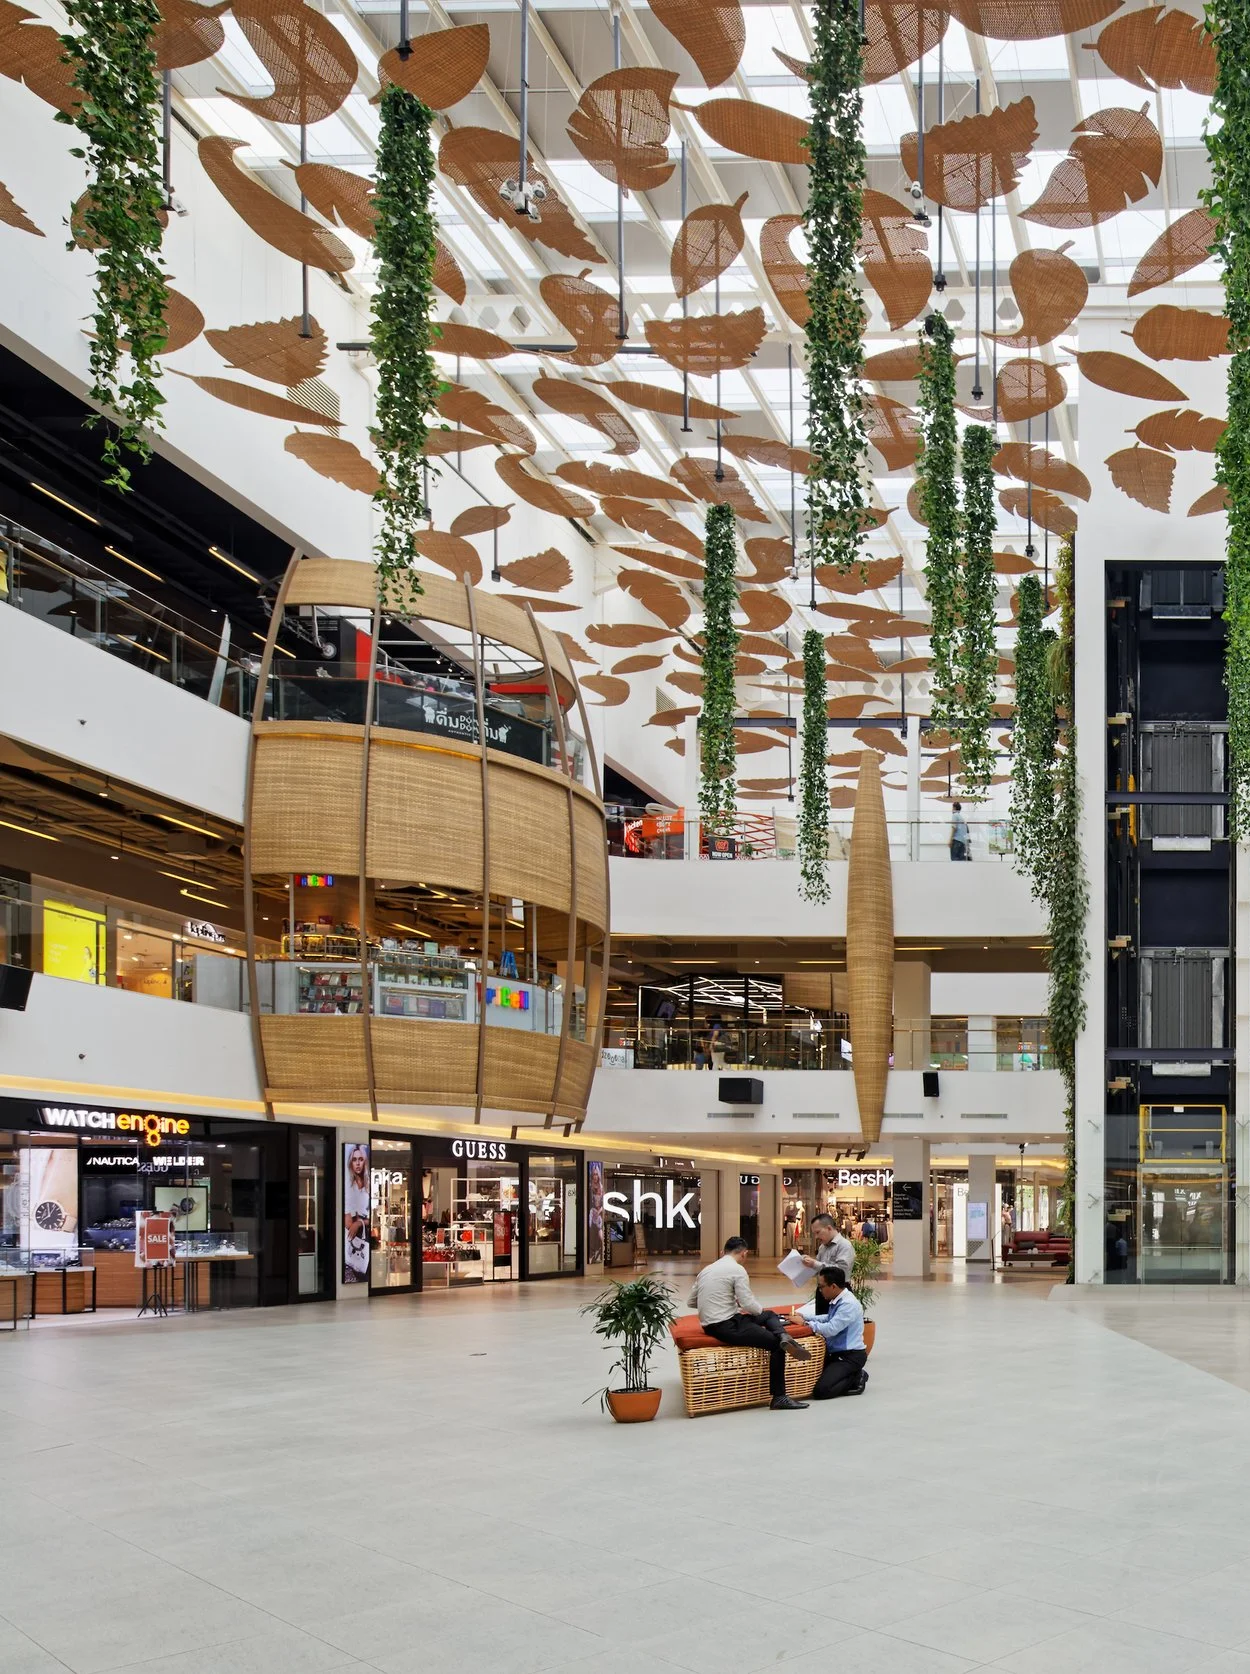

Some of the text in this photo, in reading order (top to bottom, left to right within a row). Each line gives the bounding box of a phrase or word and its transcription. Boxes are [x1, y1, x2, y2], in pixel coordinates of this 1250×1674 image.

[43, 1107, 190, 1147] WATCH engine
[452, 1140, 507, 1160] GUESS
[92, 1156, 140, 1166] NAUTICA
[838, 1169, 895, 1187] Bershk
[603, 1179, 701, 1229] shk
[147, 1234, 168, 1243] SALE
